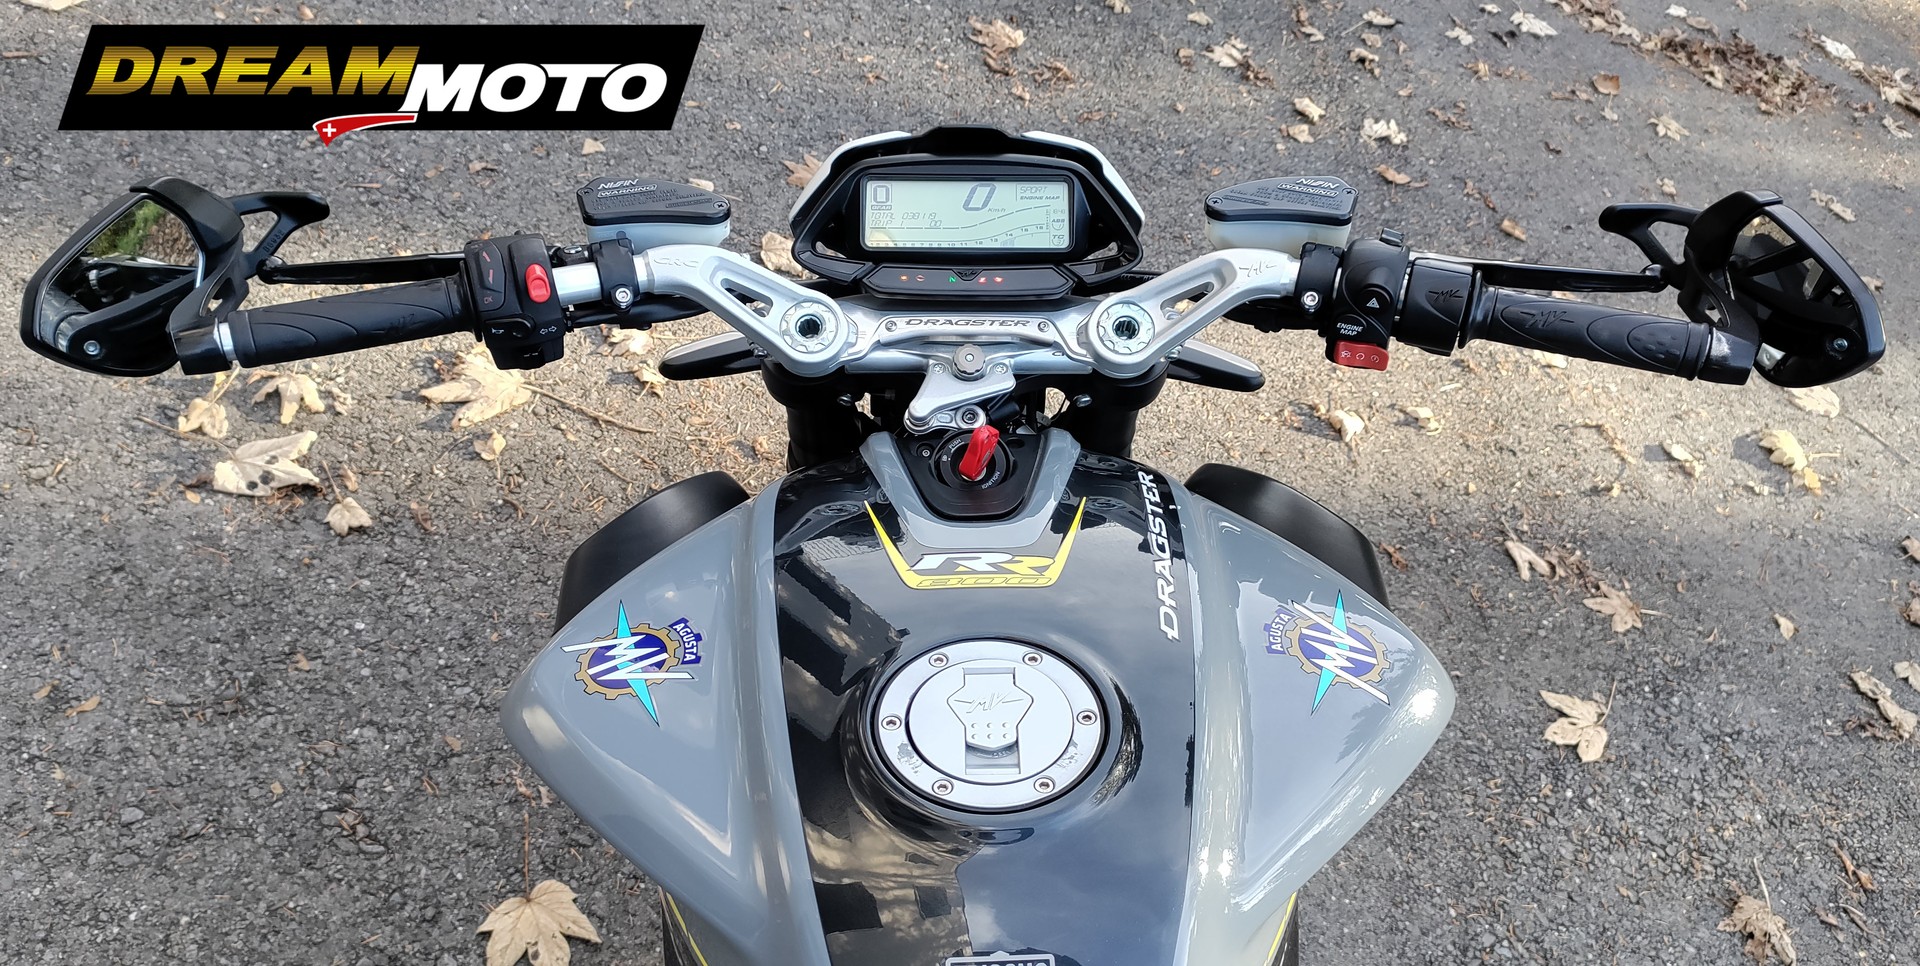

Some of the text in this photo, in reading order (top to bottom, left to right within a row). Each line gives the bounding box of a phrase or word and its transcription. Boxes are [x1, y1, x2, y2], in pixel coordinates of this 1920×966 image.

[873, 185, 890, 204] 0
[1019, 185, 1049, 194] SPORT
[962, 183, 997, 212] 0
[870, 212, 895, 220] TOTAL
[905, 318, 1031, 327] DRAGSTER
[1336, 322, 1364, 333] ENGINE
[1340, 328, 1358, 336] MAP
[948, 438, 962, 450] PUSH
[981, 471, 1001, 490] IGNITION
[1137, 470, 1181, 642] DRAGSTER
[916, 576, 1052, 588] 800
[1269, 613, 1292, 651] AGUSTA
[672, 622, 697, 662] AGUSTA
